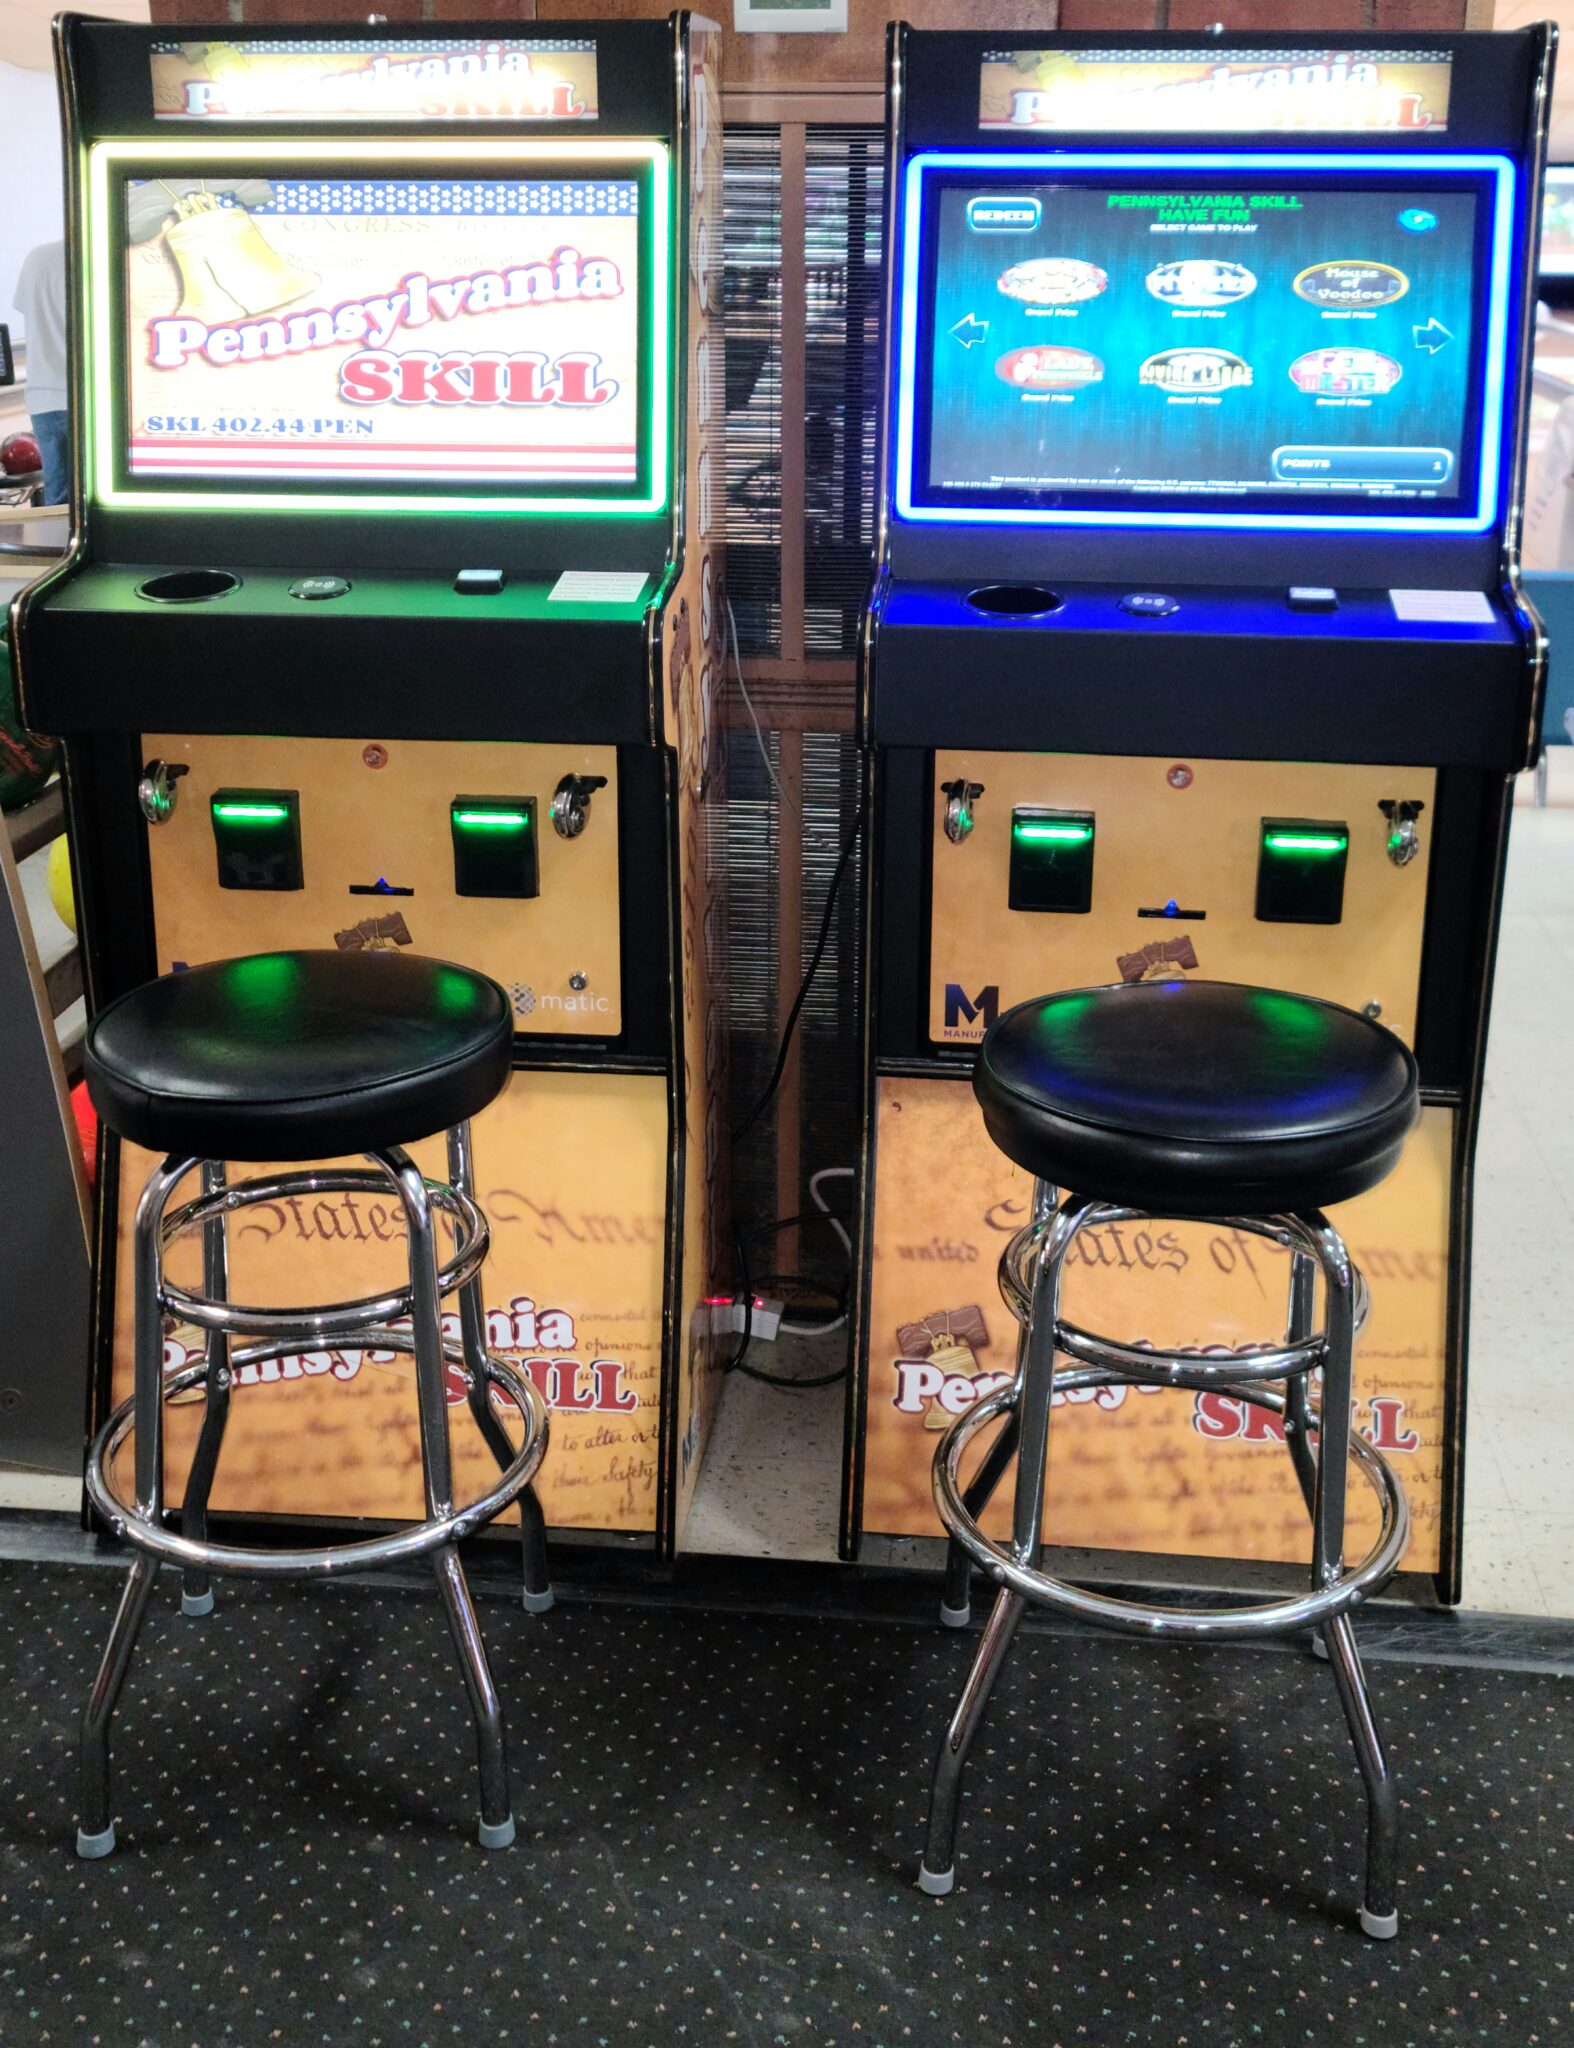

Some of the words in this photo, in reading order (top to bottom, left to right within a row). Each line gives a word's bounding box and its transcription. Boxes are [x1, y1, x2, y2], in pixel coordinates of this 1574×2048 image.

[1107, 194, 1246, 208] PENNSYLVANIA
[1249, 195, 1303, 209] SKILL
[1158, 208, 1209, 221] HAVE
[1212, 209, 1250, 222] FUN
[1149, 223, 1188, 232] SELECT
[1217, 224, 1232, 232] TO
[1233, 224, 1259, 232] PLAY
[1324, 267, 1380, 278] House
[1340, 278, 1361, 289] of
[1317, 288, 1384, 300] Voodoo
[151, 245, 624, 372] Pennsylvania
[338, 349, 619, 409] SKILL
[147, 415, 206, 432] SKL
[212, 415, 306, 434] 402.44
[313, 418, 374, 435] PEN
[1282, 458, 1331, 469] POINTS
[943, 1029, 986, 1039] MANUF
